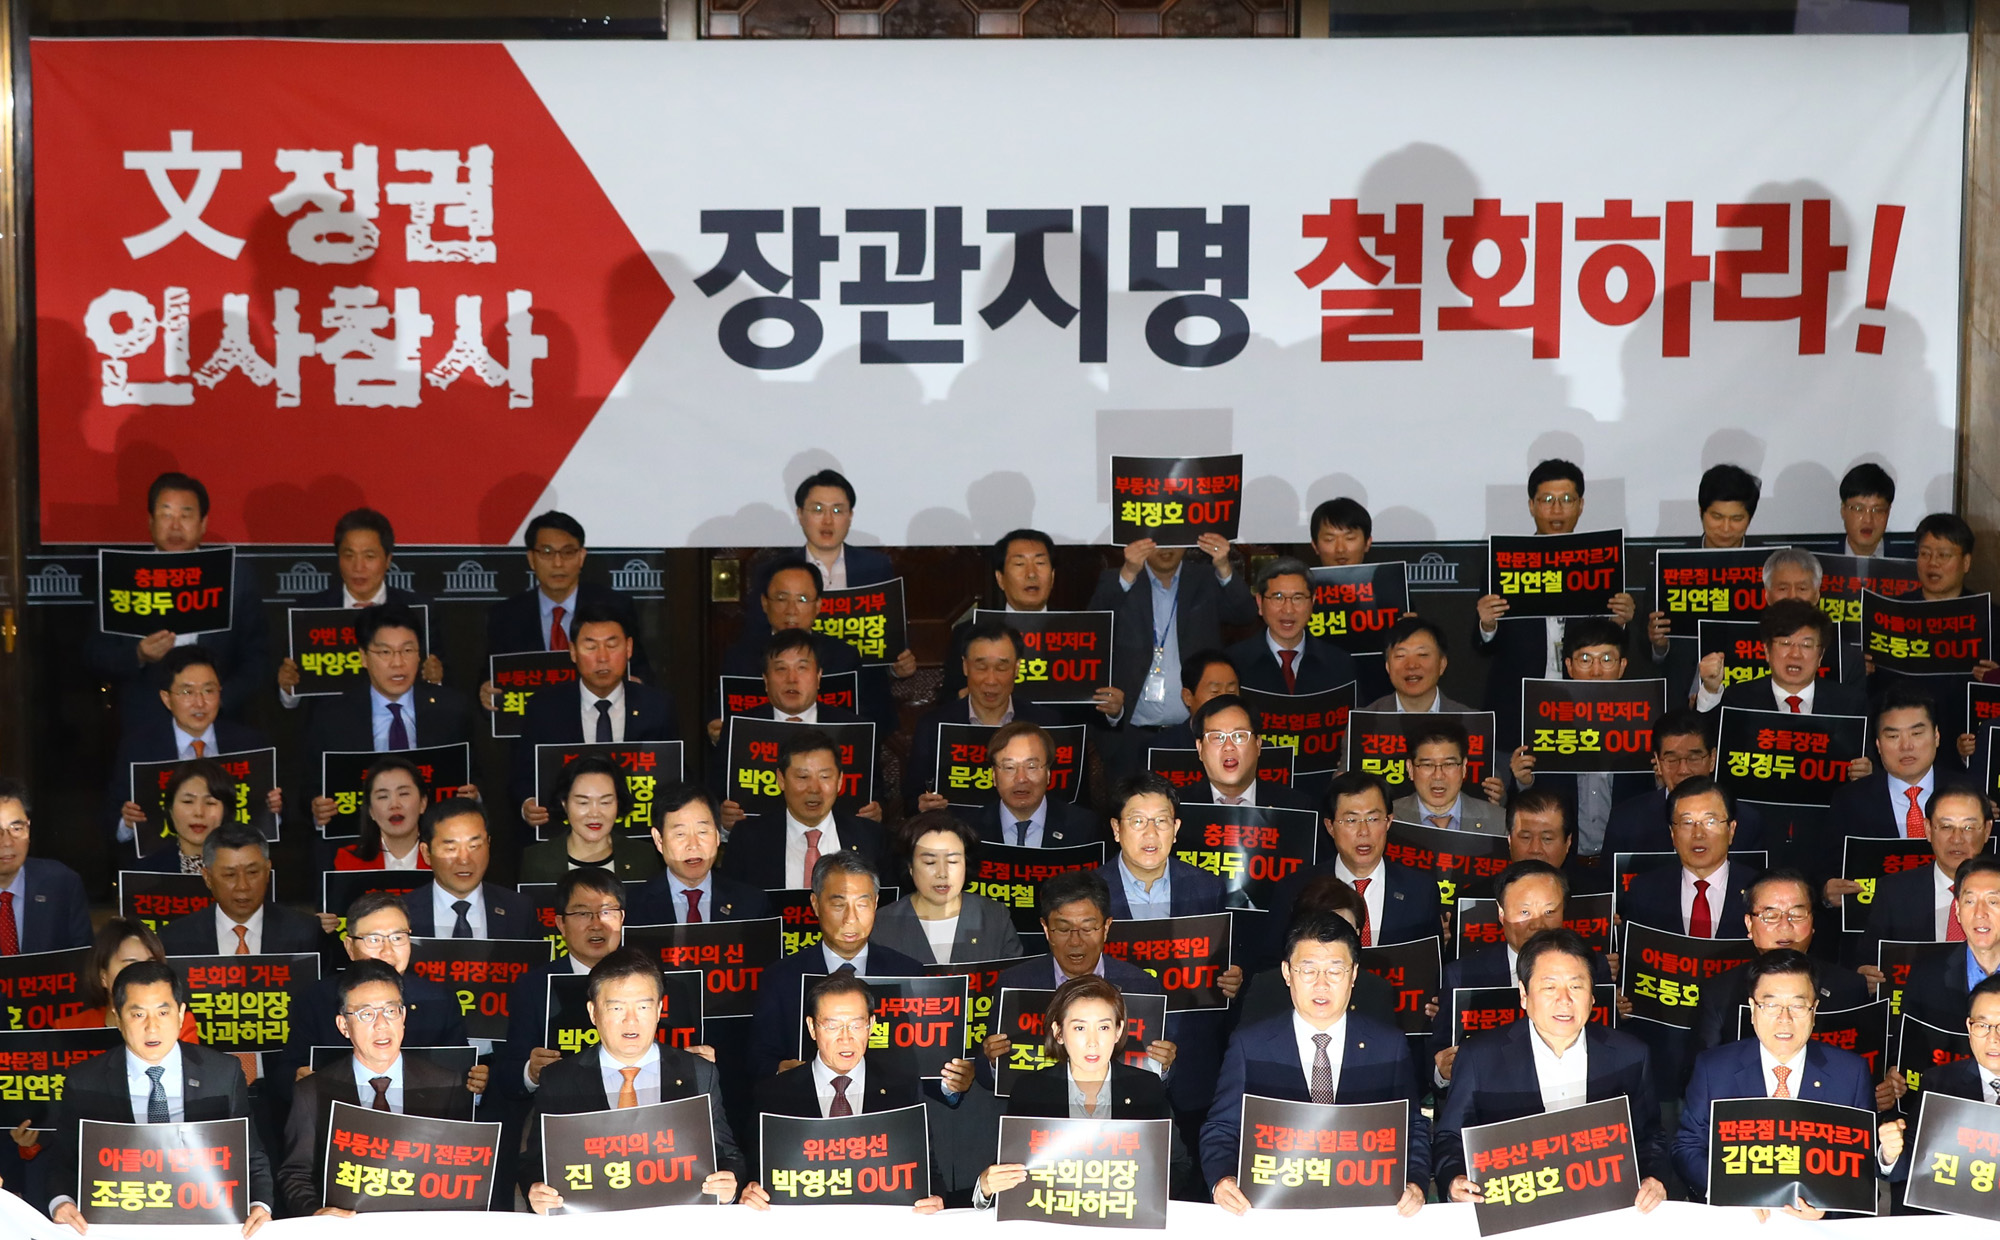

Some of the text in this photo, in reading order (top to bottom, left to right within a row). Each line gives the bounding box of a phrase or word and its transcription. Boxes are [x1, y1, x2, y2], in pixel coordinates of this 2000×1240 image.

[122, 130, 497, 264] 文 정권
[693, 198, 1906, 370] 장관지명 철회하라!
[83, 285, 548, 409] 인사참사
[1114, 474, 1240, 496] 부동산 투기 전문가
[1120, 499, 1235, 528] 최정호 OUT
[1496, 546, 1619, 569] 판문점 나무자르기
[134, 567, 202, 588] 충돌장관
[1499, 568, 1615, 594] 김연철 OUT
[1663, 568, 1709, 585] 판문점
[110, 587, 223, 616] 정경두 OUT
[817, 592, 887, 615] 회의 거부
[1666, 587, 1766, 612] 김연철 OU
[1819, 598, 1863, 623] 정호
[1307, 607, 1399, 637] 영선 OUT
[1874, 612, 1976, 633] 아들이 먼저다
[309, 628, 337, 646] 9번
[1045, 632, 1097, 651] 먼저다
[1869, 632, 1981, 658] 조동호 OUT
[498, 669, 575, 686] 부동산 투기
[1052, 659, 1102, 681] OUT
[1538, 700, 1651, 722] 아들이 먼저다
[749, 741, 778, 763] 9번
[1532, 728, 1653, 755] 조동호 OUT
[1756, 728, 1830, 753] 충돌장관
[621, 751, 657, 770] 거부
[1727, 751, 1853, 782] 정경두 OUT
[948, 765, 994, 790] 문성
[1203, 823, 1280, 850] 충돌장관
[1248, 854, 1303, 882] OUT
[1385, 843, 1435, 870] 부동산
[1435, 852, 1470, 874] 투기
[661, 943, 744, 967] 딱지의 신
[1132, 935, 1211, 961] 위장전입
[1641, 948, 1699, 977] 아들이
[18, 972, 77, 997] 먼저다
[186, 965, 291, 989] 본회의 거부
[706, 967, 764, 994] OUT
[1162, 965, 1219, 991] OUT
[1385, 966, 1405, 987] 신
[1634, 972, 1700, 1007] 조동호
[188, 991, 291, 1020] 국회의장
[480, 991, 509, 1017] OU
[195, 1020, 291, 1045] 사과하라
[894, 1021, 955, 1048] OUT
[332, 1128, 494, 1167] 부동산 투기 전문가
[583, 1129, 675, 1159] 딱지의 신
[802, 1132, 889, 1161] 위선영선
[1096, 1131, 1141, 1156] 거부
[1253, 1123, 1398, 1153] 건강보험료 0원
[1473, 1122, 1630, 1173] 부동산 투기 전문가
[1717, 1118, 1871, 1152] 판문점 나무자르기
[97, 1146, 164, 1173] 아들이
[564, 1154, 699, 1191] 진 영 OUT
[1250, 1154, 1399, 1187] 문성혁 OUT
[1721, 1143, 1868, 1179] 김연철 OUT
[1930, 1152, 1998, 1193] 진 영
[335, 1160, 484, 1200] 최정호 OUT
[771, 1161, 918, 1198] 박영선 OUT
[1028, 1160, 1138, 1191] 국회의장
[1483, 1152, 1626, 1206] 최정호 OUT
[90, 1179, 240, 1212] 조동호 OUT
[1026, 1189, 1138, 1220] 사과하라
